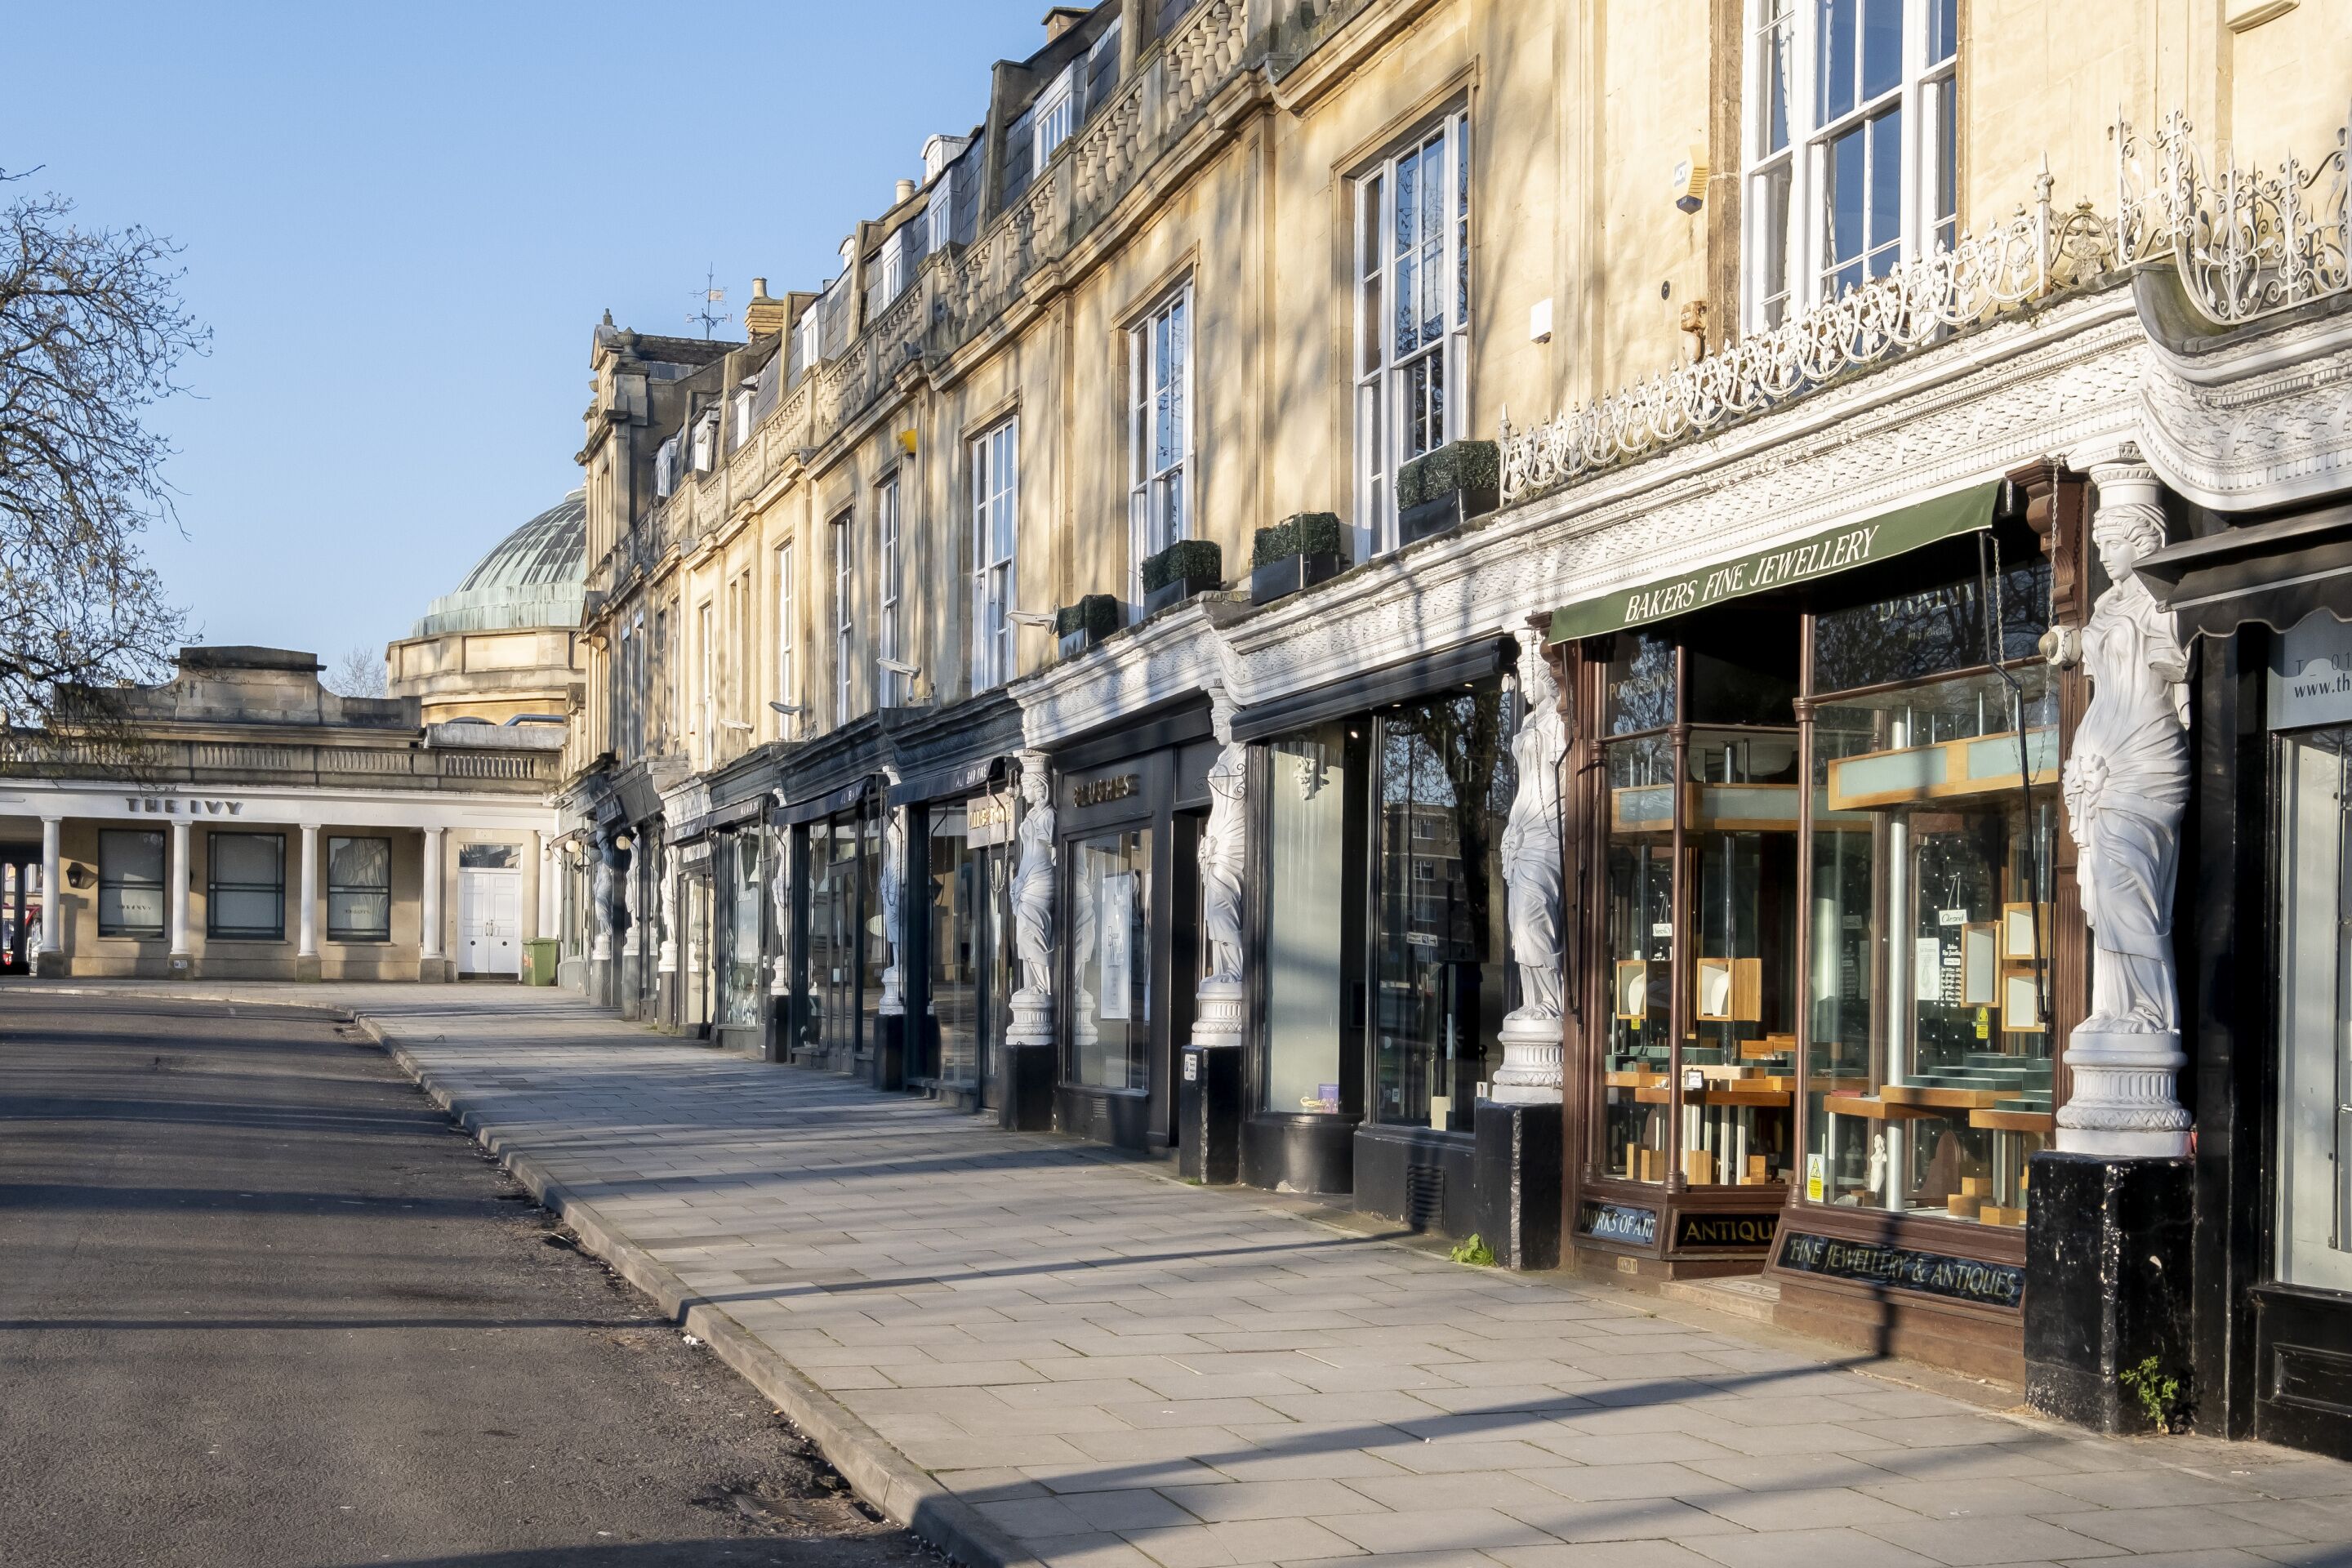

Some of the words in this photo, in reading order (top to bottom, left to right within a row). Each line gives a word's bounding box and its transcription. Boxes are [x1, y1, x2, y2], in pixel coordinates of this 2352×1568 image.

[1624, 579, 1698, 622] BAKERS
[1702, 562, 1748, 602] FINE
[1749, 524, 1880, 587] JEWELLERY
[126, 798, 180, 813] THE
[189, 800, 244, 816] IVY
[1582, 1208, 1619, 1233] WORKS
[1619, 1214, 1634, 1234] OF
[1633, 1216, 1656, 1238] ART
[1684, 1220, 1779, 1242] ANTIQU
[1790, 1238, 1824, 1265] FINE
[1823, 1244, 1907, 1278] JEWELLERY
[1912, 1258, 1925, 1283] &
[1930, 1263, 2016, 1298] ANTIQUES
